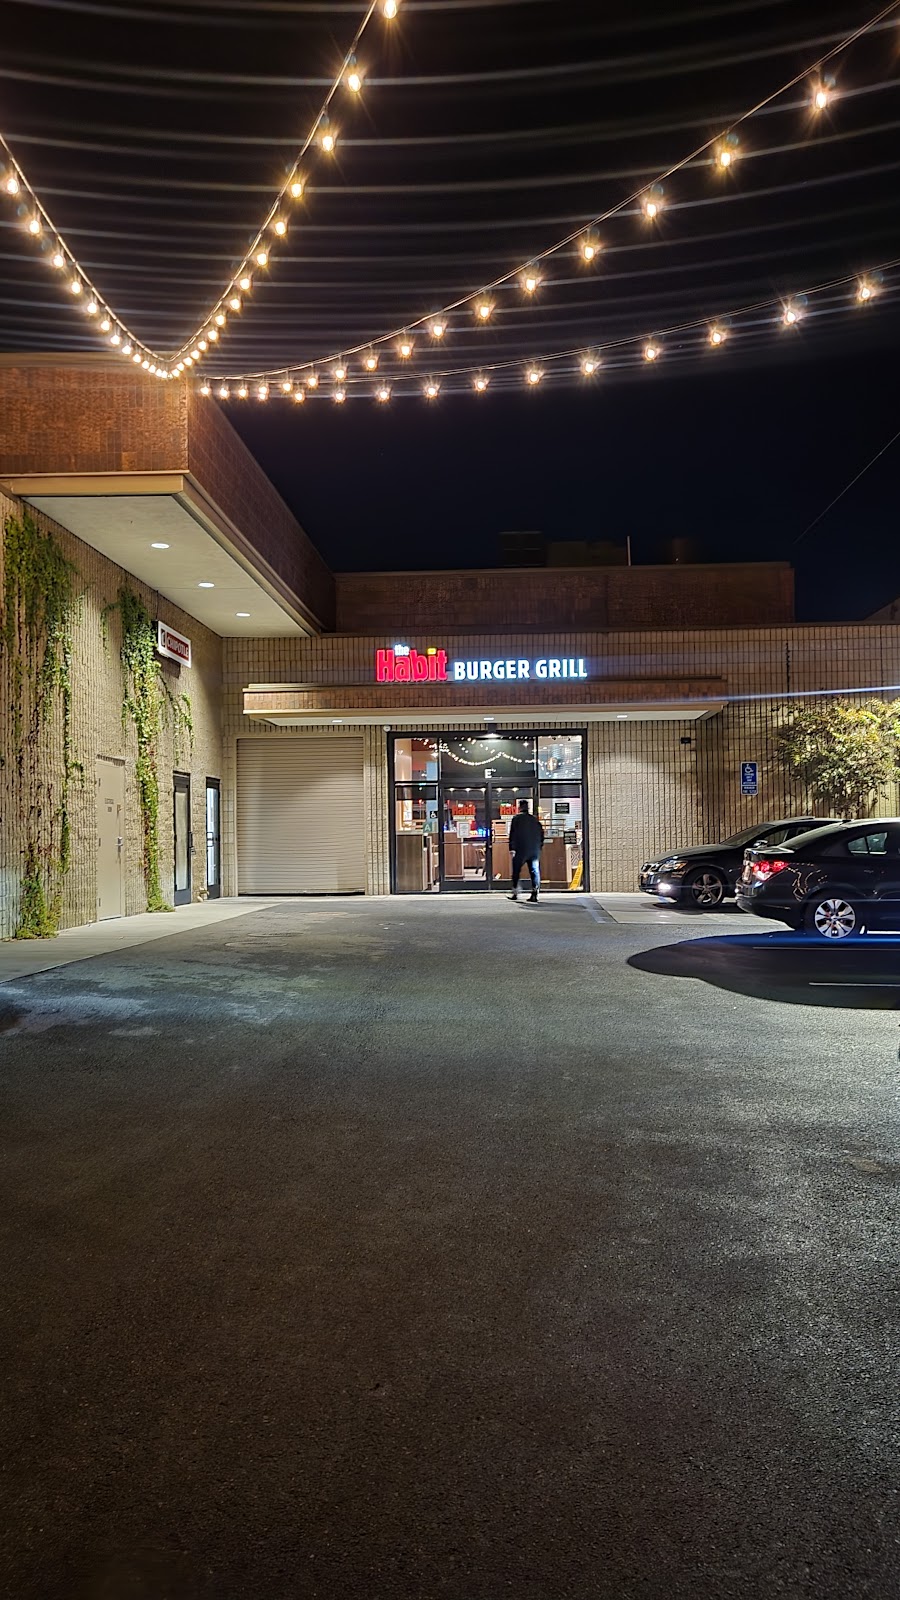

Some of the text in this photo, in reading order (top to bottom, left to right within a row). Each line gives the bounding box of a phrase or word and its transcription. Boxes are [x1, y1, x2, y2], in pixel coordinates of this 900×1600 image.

[394, 644, 410, 656] the
[376, 648, 588, 682] Habit BURGER GRILL
